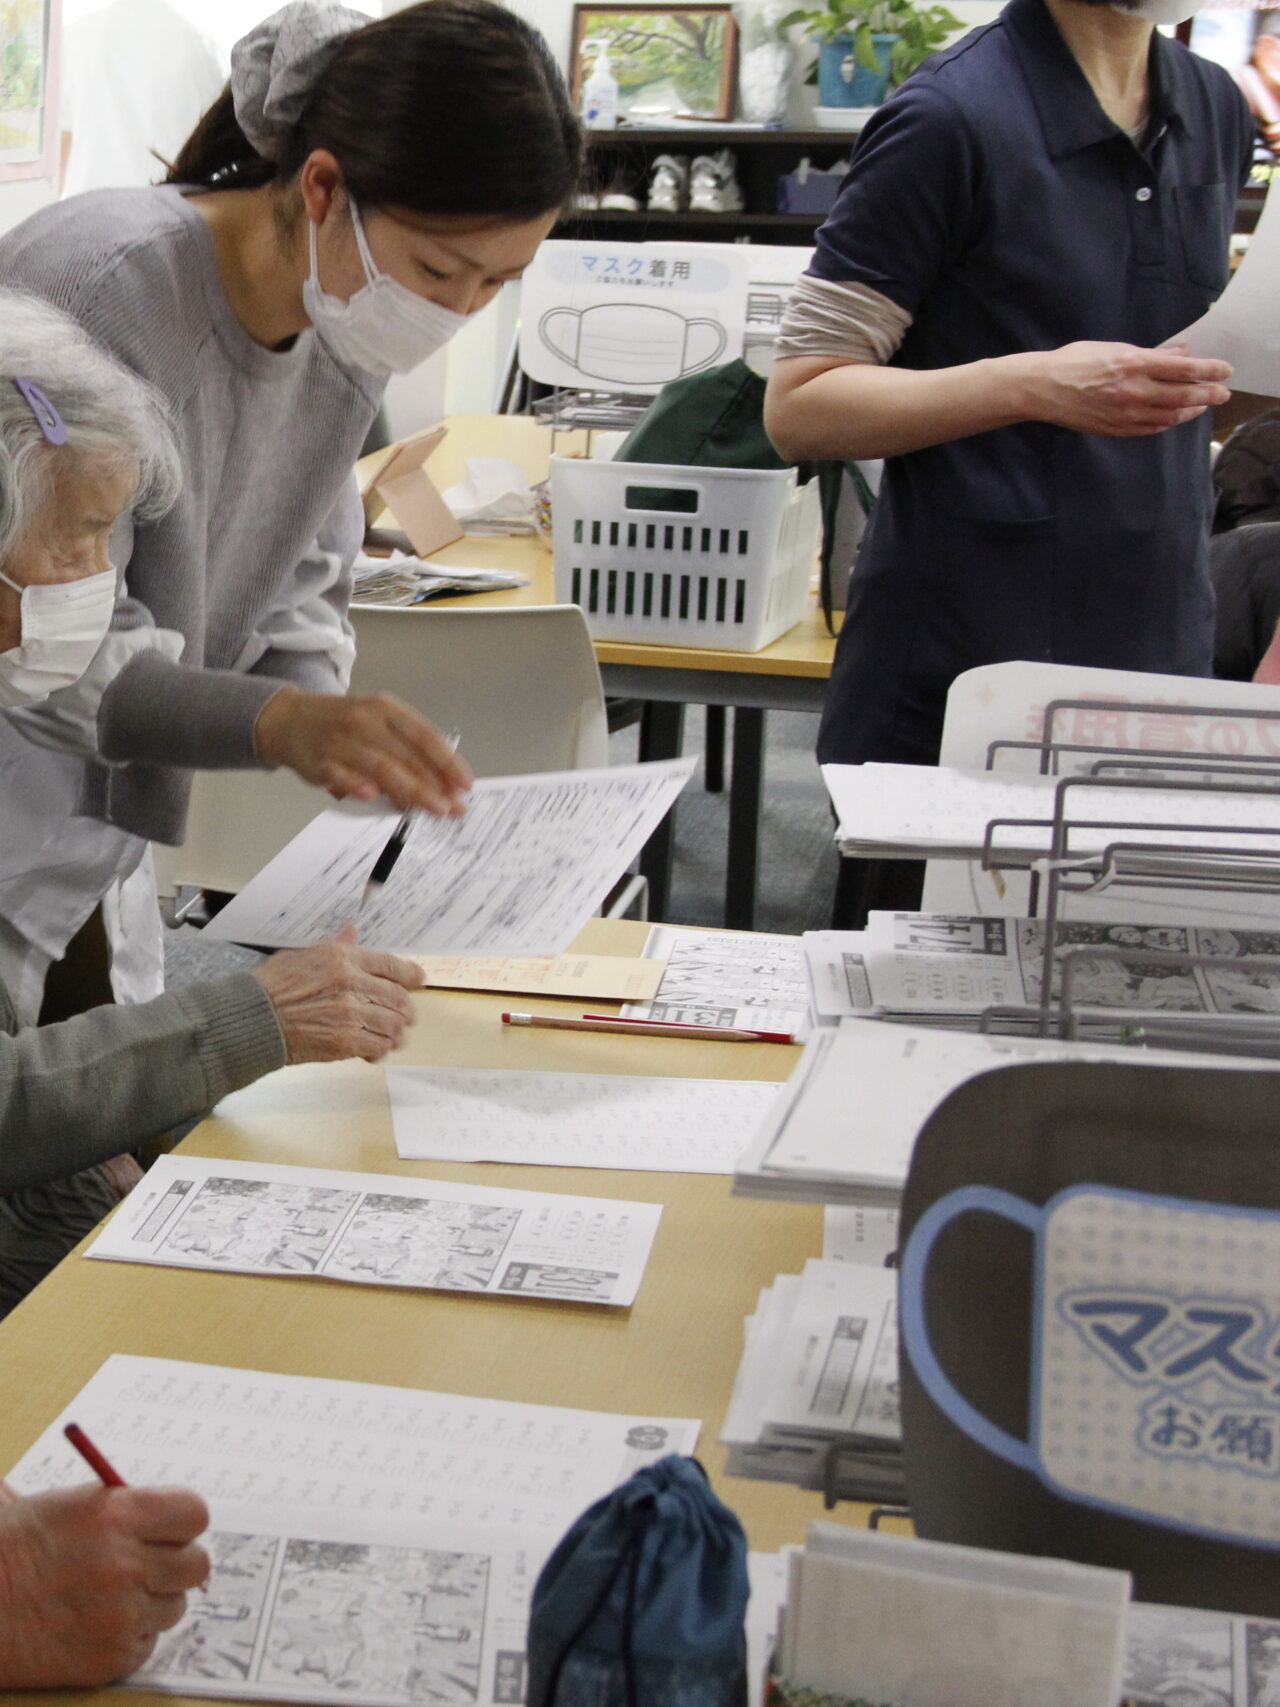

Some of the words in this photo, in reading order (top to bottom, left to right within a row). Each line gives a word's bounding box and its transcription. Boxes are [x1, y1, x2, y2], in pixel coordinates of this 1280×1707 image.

[581, 255, 691, 280] マスク着用
[1070, 1300, 1280, 1395] マス
